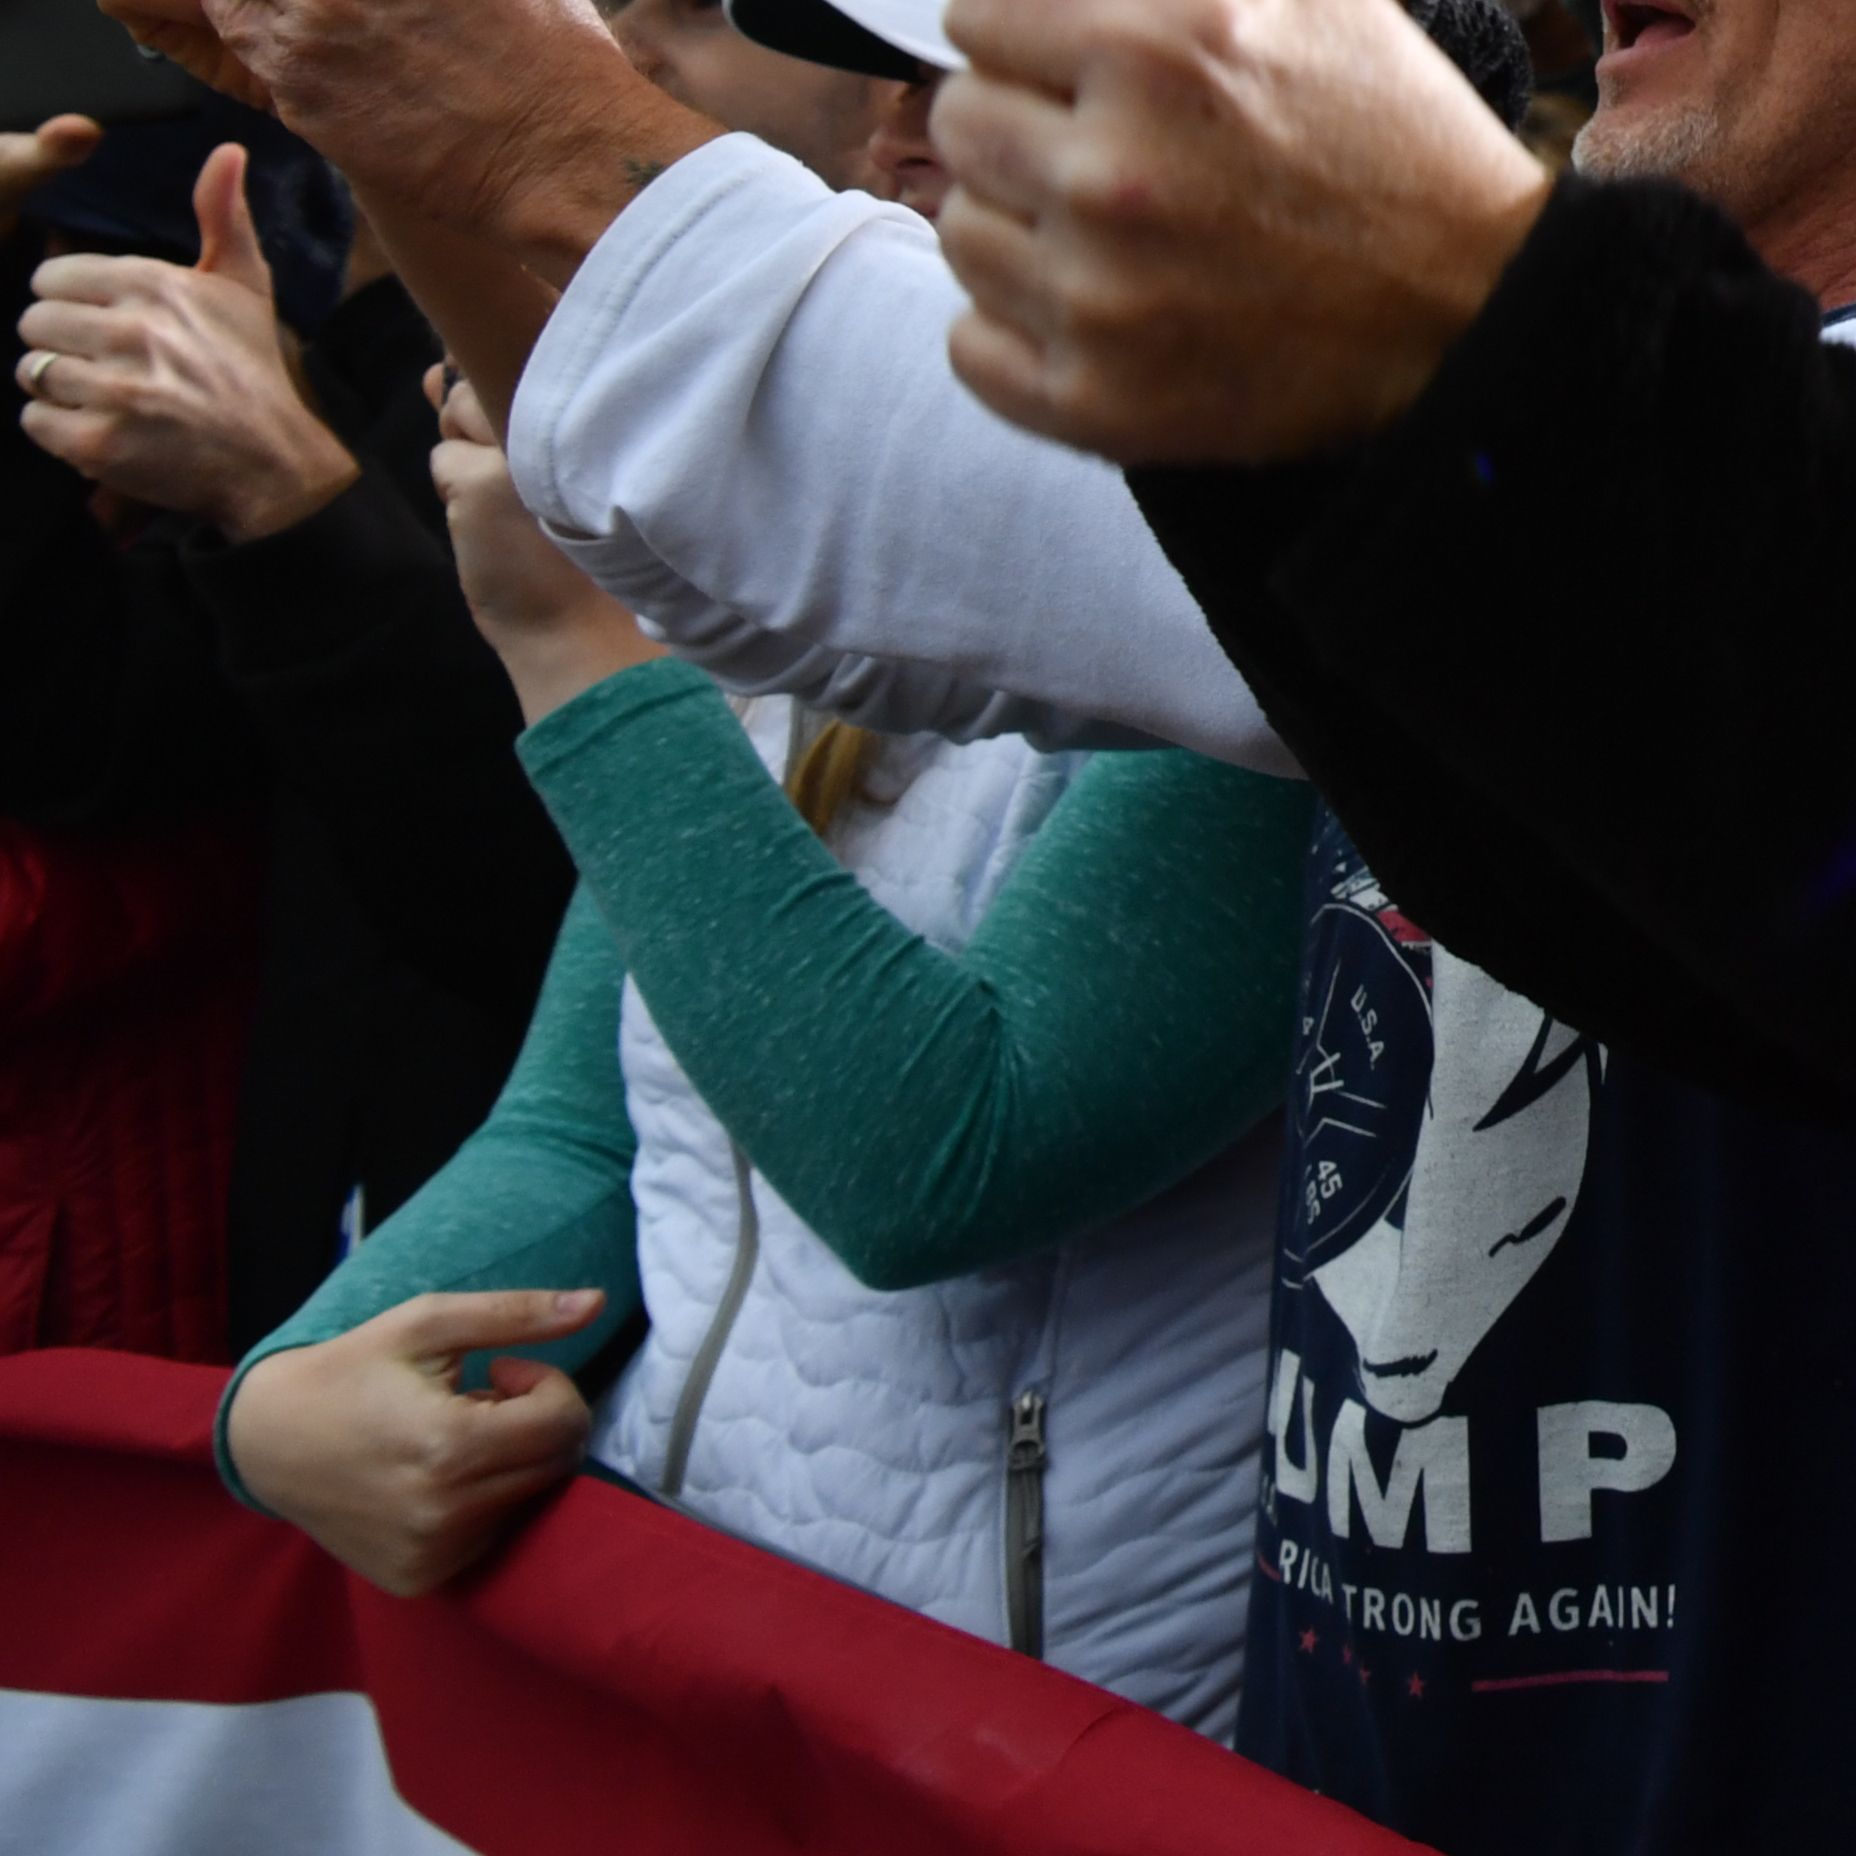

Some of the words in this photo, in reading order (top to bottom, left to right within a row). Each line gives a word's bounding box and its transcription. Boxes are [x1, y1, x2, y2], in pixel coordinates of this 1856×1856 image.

[1316, 1157, 1343, 1200] 45
[1341, 1582, 1483, 1643] TRONG
[1506, 1580, 1680, 1638] AGAIN!
